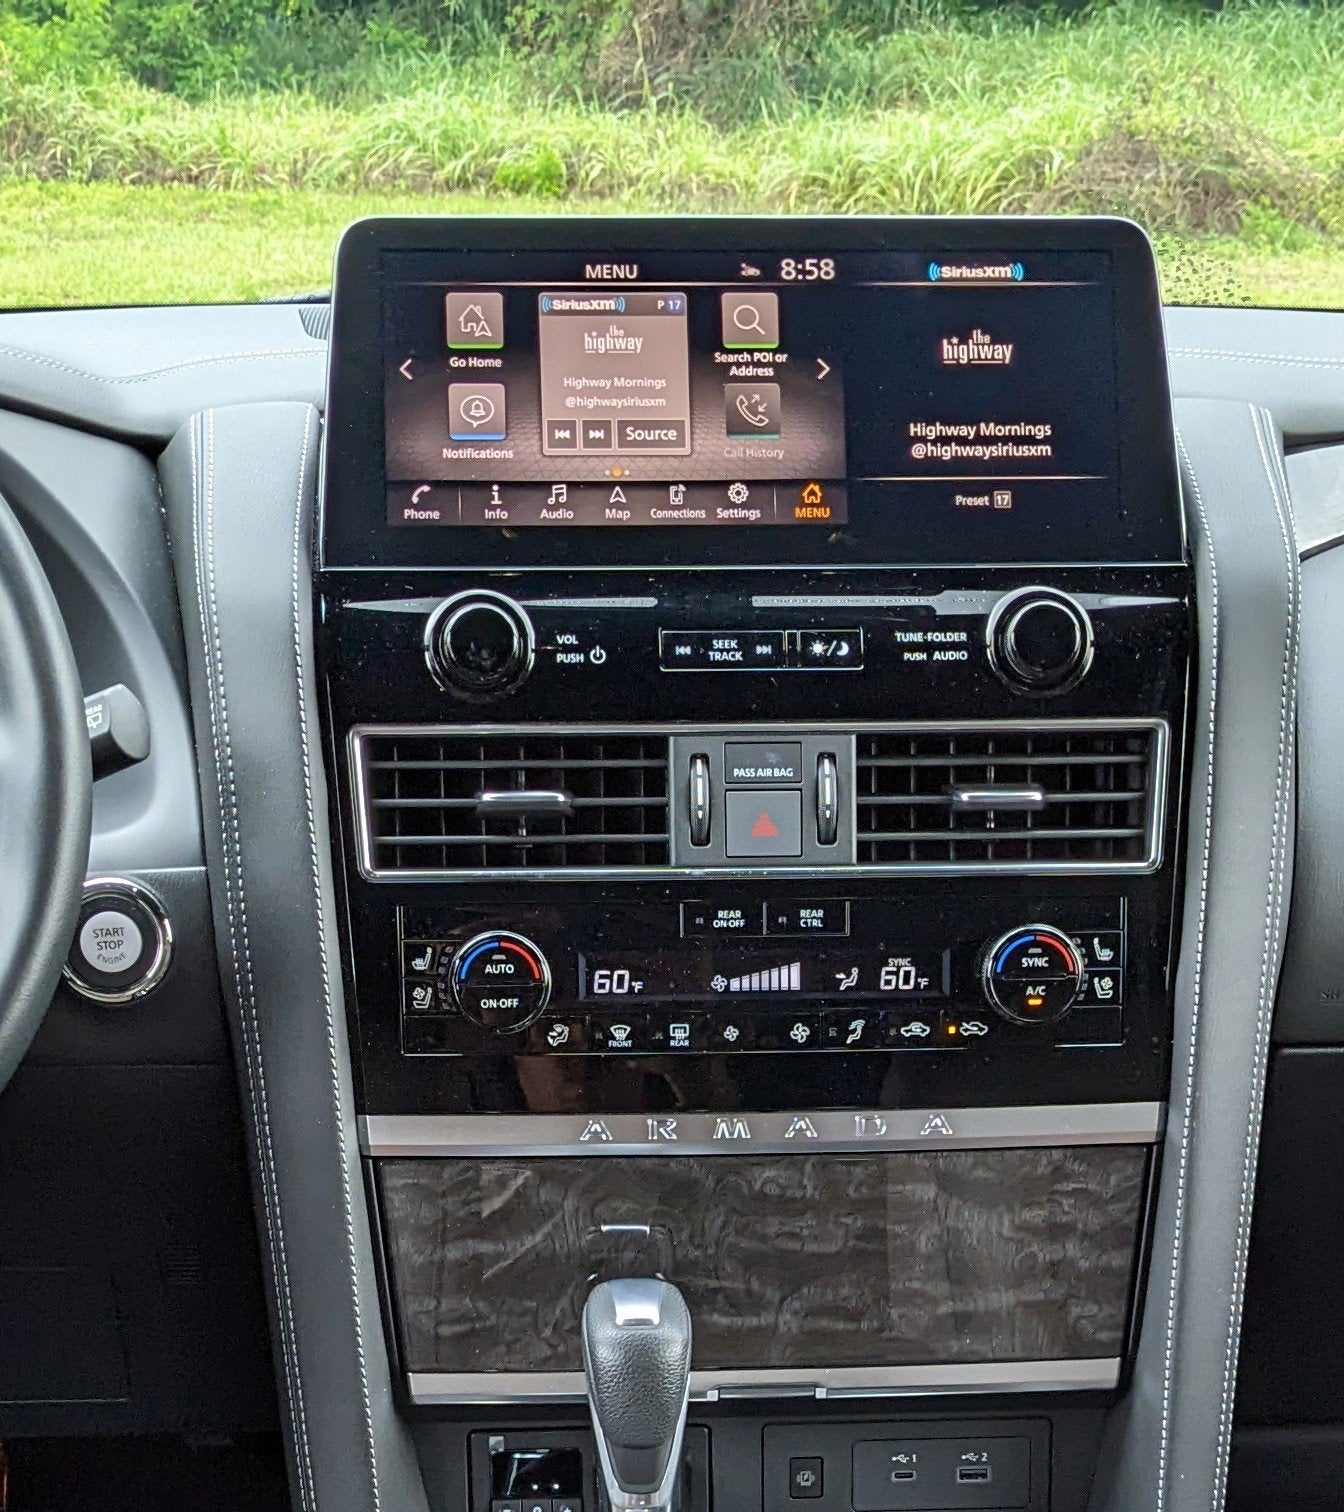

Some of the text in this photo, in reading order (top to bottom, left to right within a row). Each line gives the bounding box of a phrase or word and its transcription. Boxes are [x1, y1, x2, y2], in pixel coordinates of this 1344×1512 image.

[585, 264, 638, 279] MENU
[780, 258, 836, 280] 8:58
[668, 300, 681, 311] 17
[609, 325, 624, 337] the
[972, 328, 991, 344] the
[584, 332, 643, 353] highway
[942, 337, 1013, 364] highway
[449, 357, 502, 368] Go Home
[714, 352, 788, 363] Search POI or
[729, 365, 774, 377] Address
[563, 377, 667, 389] Highway Mornings
[565, 396, 666, 409] @highwaysiriusxm
[626, 427, 677, 441] Source
[909, 422, 1052, 439] Highway Mornings
[442, 448, 513, 460] Notifications
[724, 447, 784, 460] Call History
[911, 442, 1052, 460] @highwaysiriusxm
[955, 494, 1009, 506] Preset 17
[404, 508, 440, 520] Phone
[484, 508, 509, 520] Info
[540, 508, 574, 520] Audio
[605, 508, 631, 522] Map
[650, 508, 706, 519] Connections
[716, 507, 761, 521] Settings
[795, 507, 832, 519] MENU
[556, 635, 578, 645] VOL
[712, 639, 738, 650] SEEK
[556, 652, 584, 664] PUSH
[708, 651, 743, 662] TRACK
[903, 650, 968, 661] PUSH AUDIO
[733, 767, 755, 778] PASS
[718, 910, 742, 919] REAR
[799, 909, 824, 918] REAR
[800, 918, 824, 928] CTRL
[93, 926, 125, 938] START
[96, 939, 124, 951] STOP
[96, 952, 128, 965] ENGINE
[887, 957, 912, 967] SYNC
[1021, 956, 1049, 968] SYNC
[484, 963, 515, 975] AUTO
[1025, 985, 1047, 997] A/C
[608, 1039, 633, 1048] FRONT
[669, 1039, 690, 1047] REAR
[579, 1114, 954, 1141] ARMADA
